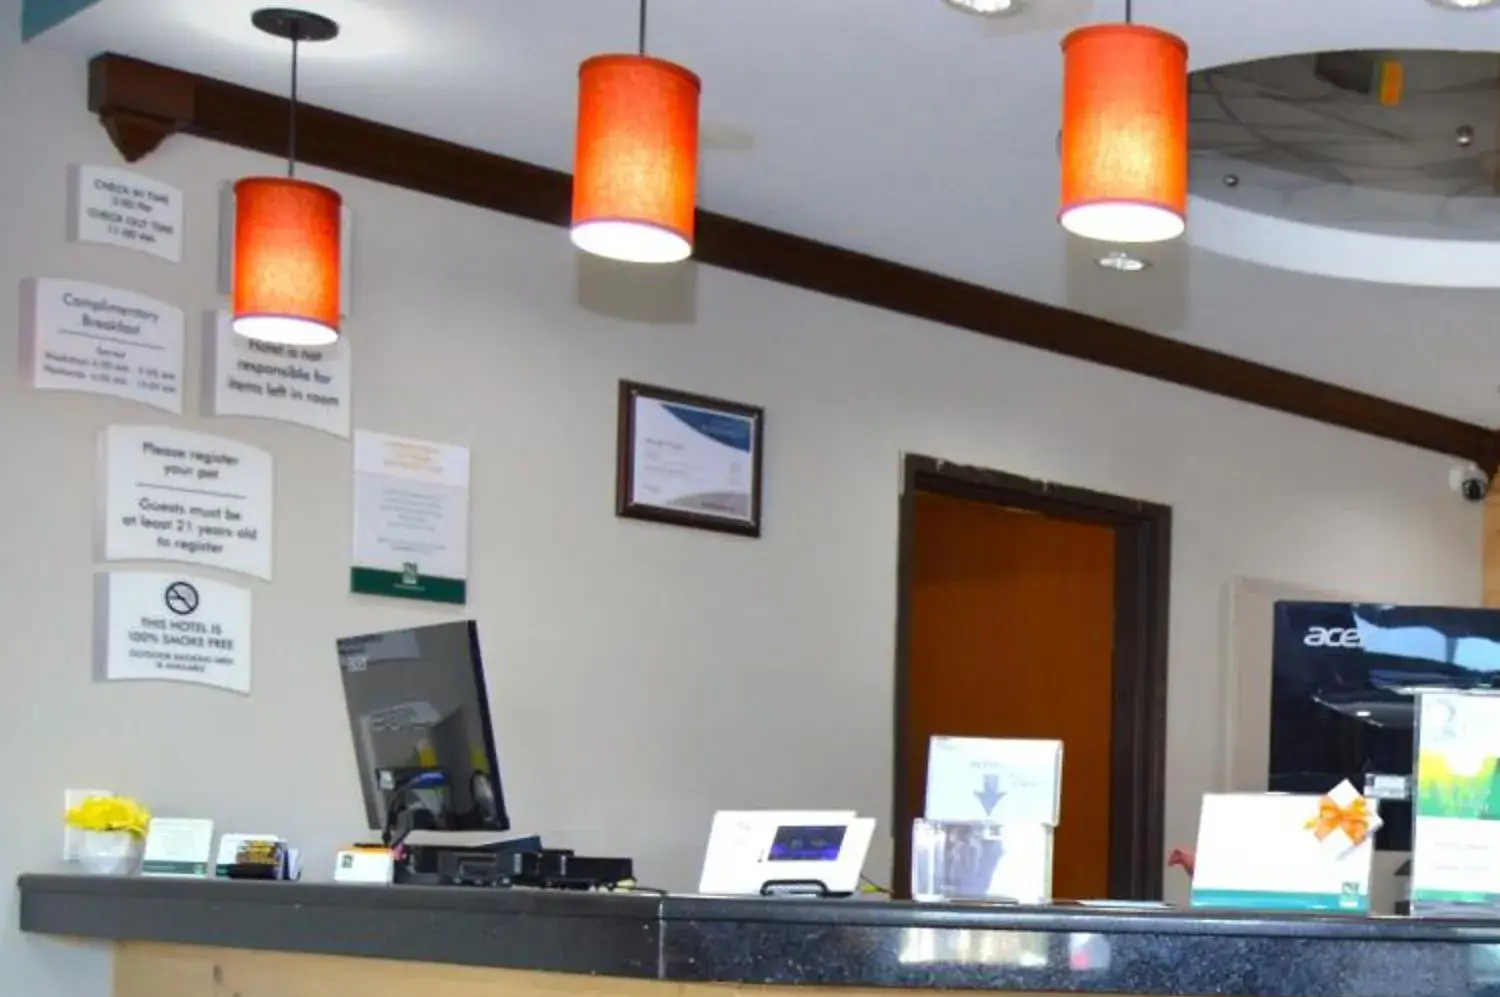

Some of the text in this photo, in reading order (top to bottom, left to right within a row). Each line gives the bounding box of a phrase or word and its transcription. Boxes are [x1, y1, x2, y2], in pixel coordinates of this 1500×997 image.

[63, 292, 159, 325] Complimentary
[82, 312, 141, 336] Breakfast
[301, 349, 322, 362] not
[237, 359, 332, 385] responsible for
[227, 376, 340, 407] items left in room
[142, 441, 240, 467] Please register
[163, 464, 219, 481] your pet
[138, 497, 242, 522] Guests must be
[121, 514, 257, 541] at least 21 years old
[156, 536, 224, 556] to register
[141, 617, 222, 636] THIS HOTEL IS
[1303, 624, 1374, 649] ace
[128, 630, 234, 651] 100% SMOKE FREE
